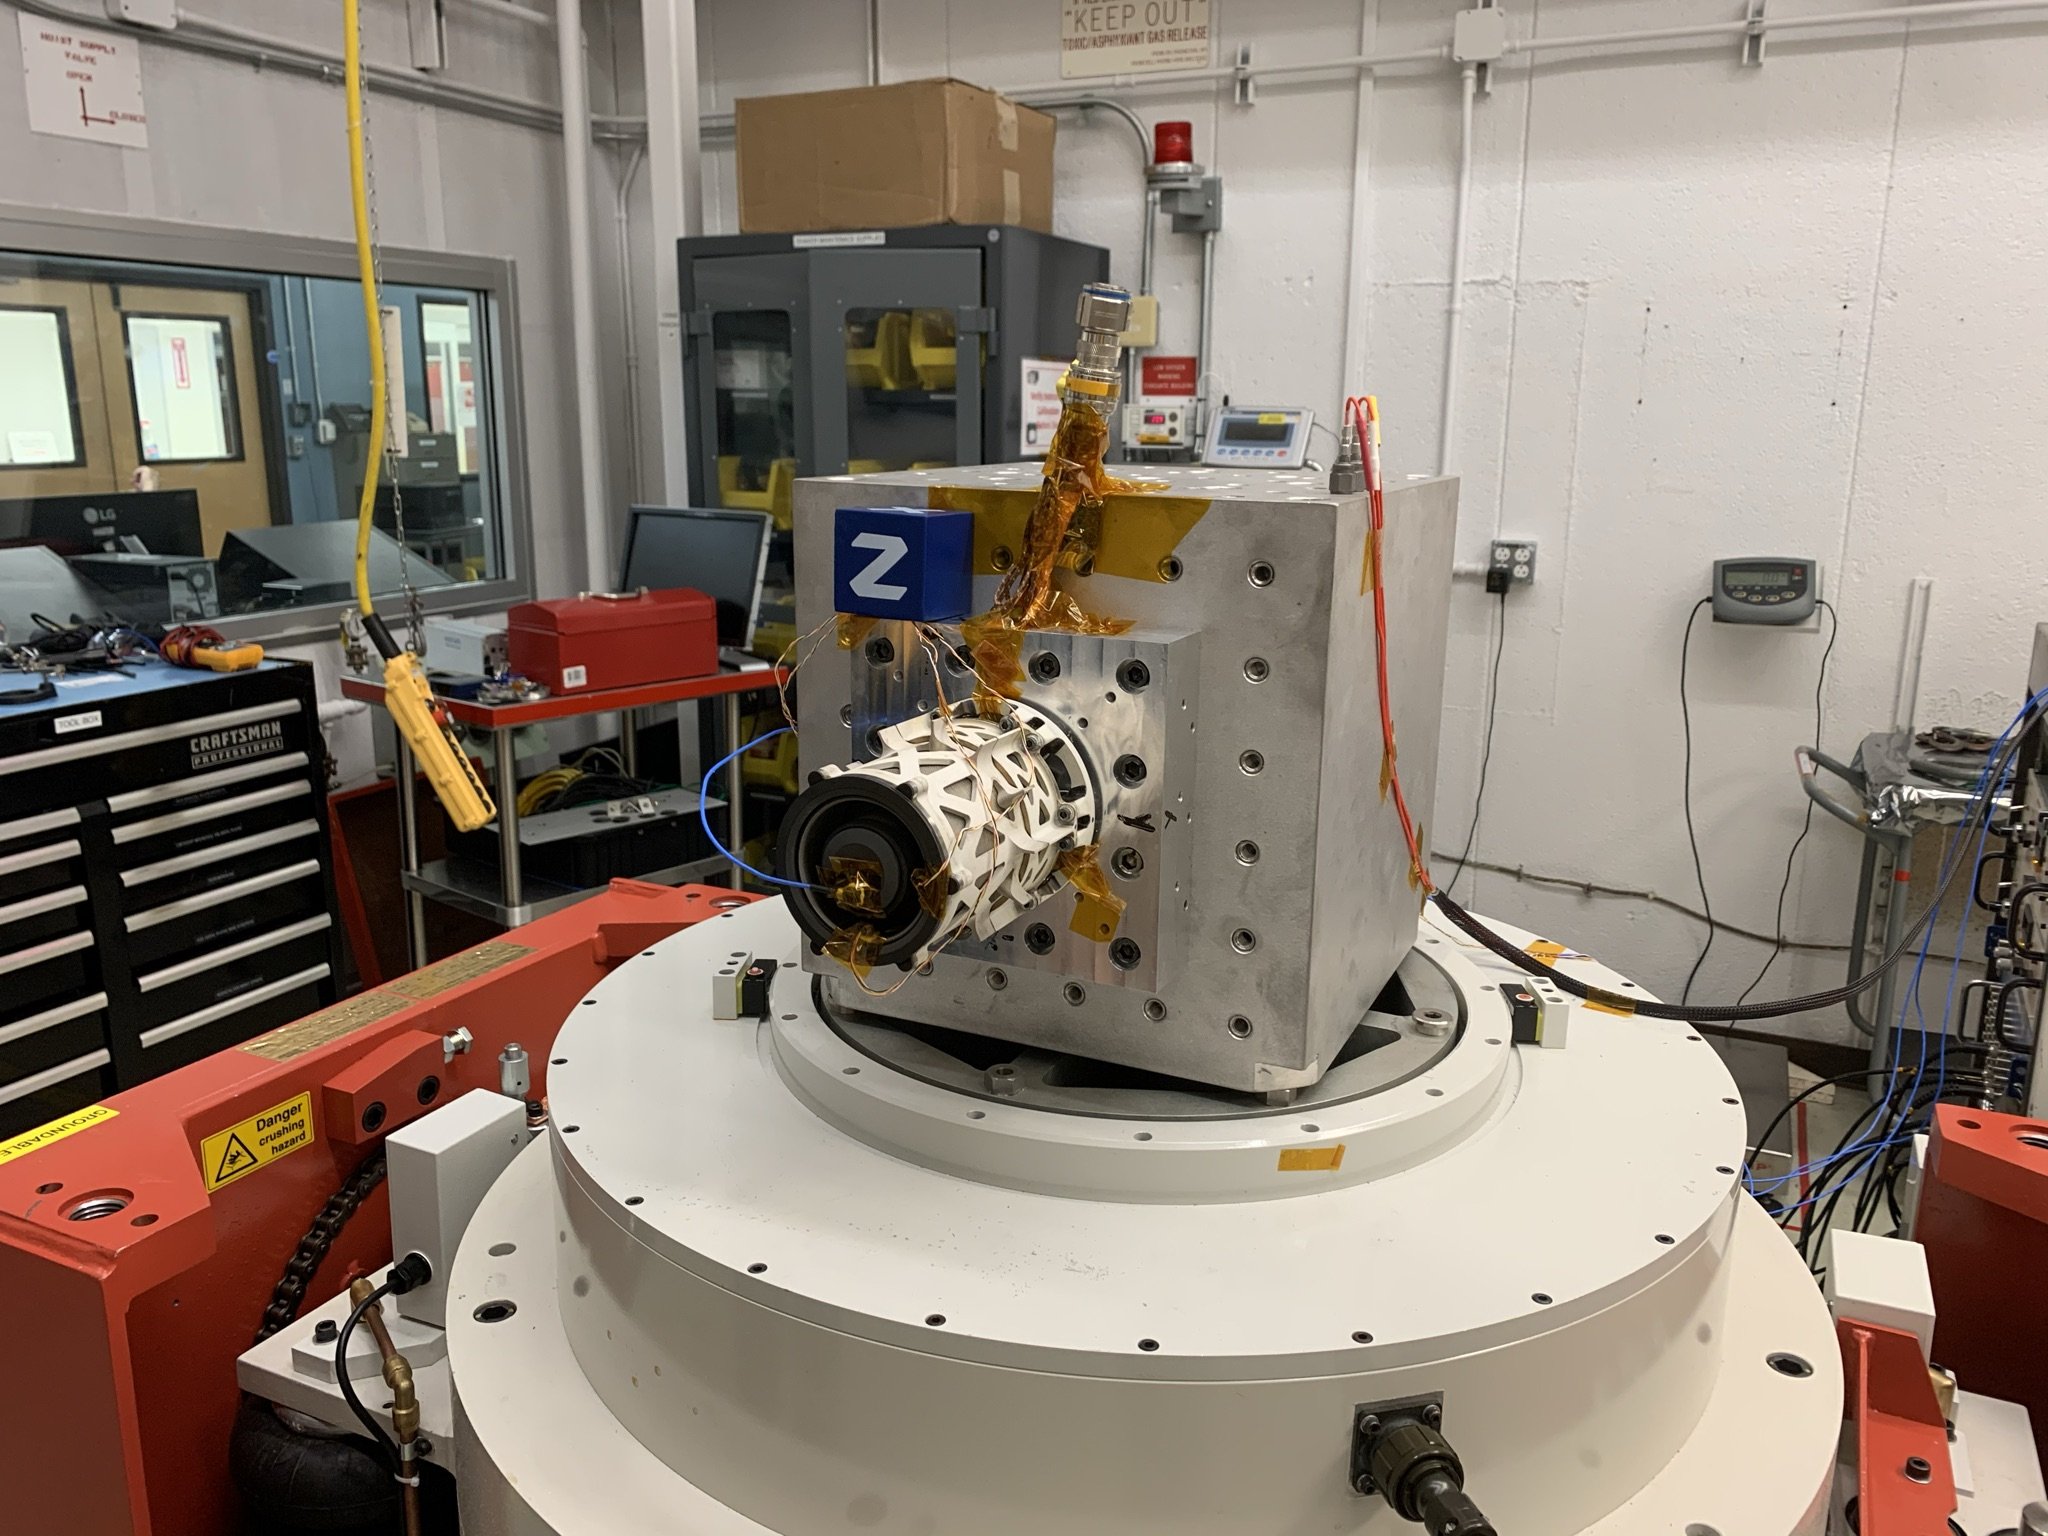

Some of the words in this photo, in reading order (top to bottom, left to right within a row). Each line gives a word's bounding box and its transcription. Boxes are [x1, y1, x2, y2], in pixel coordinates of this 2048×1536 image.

[40, 32, 72, 46] HOIST
[79, 40, 116, 55] SUPPLY
[1148, 29, 1166, 45] GAS
[1167, 25, 1207, 42] RELEASE
[65, 51, 97, 65] VALVE
[66, 70, 93, 82] OPEN
[99, 508, 117, 521] LG
[849, 532, 908, 601] Z
[58, 718, 81, 729] TOOL
[82, 714, 99, 725] BOX
[190, 720, 282, 753] CRAFTSMAN
[193, 739, 282, 767] PROFESSIONAL
[256, 1102, 303, 1132] Danger
[0, 1109, 108, 1157] GROUNDABLE
[259, 1118, 305, 1147] crushing
[271, 1130, 306, 1156] hazard
